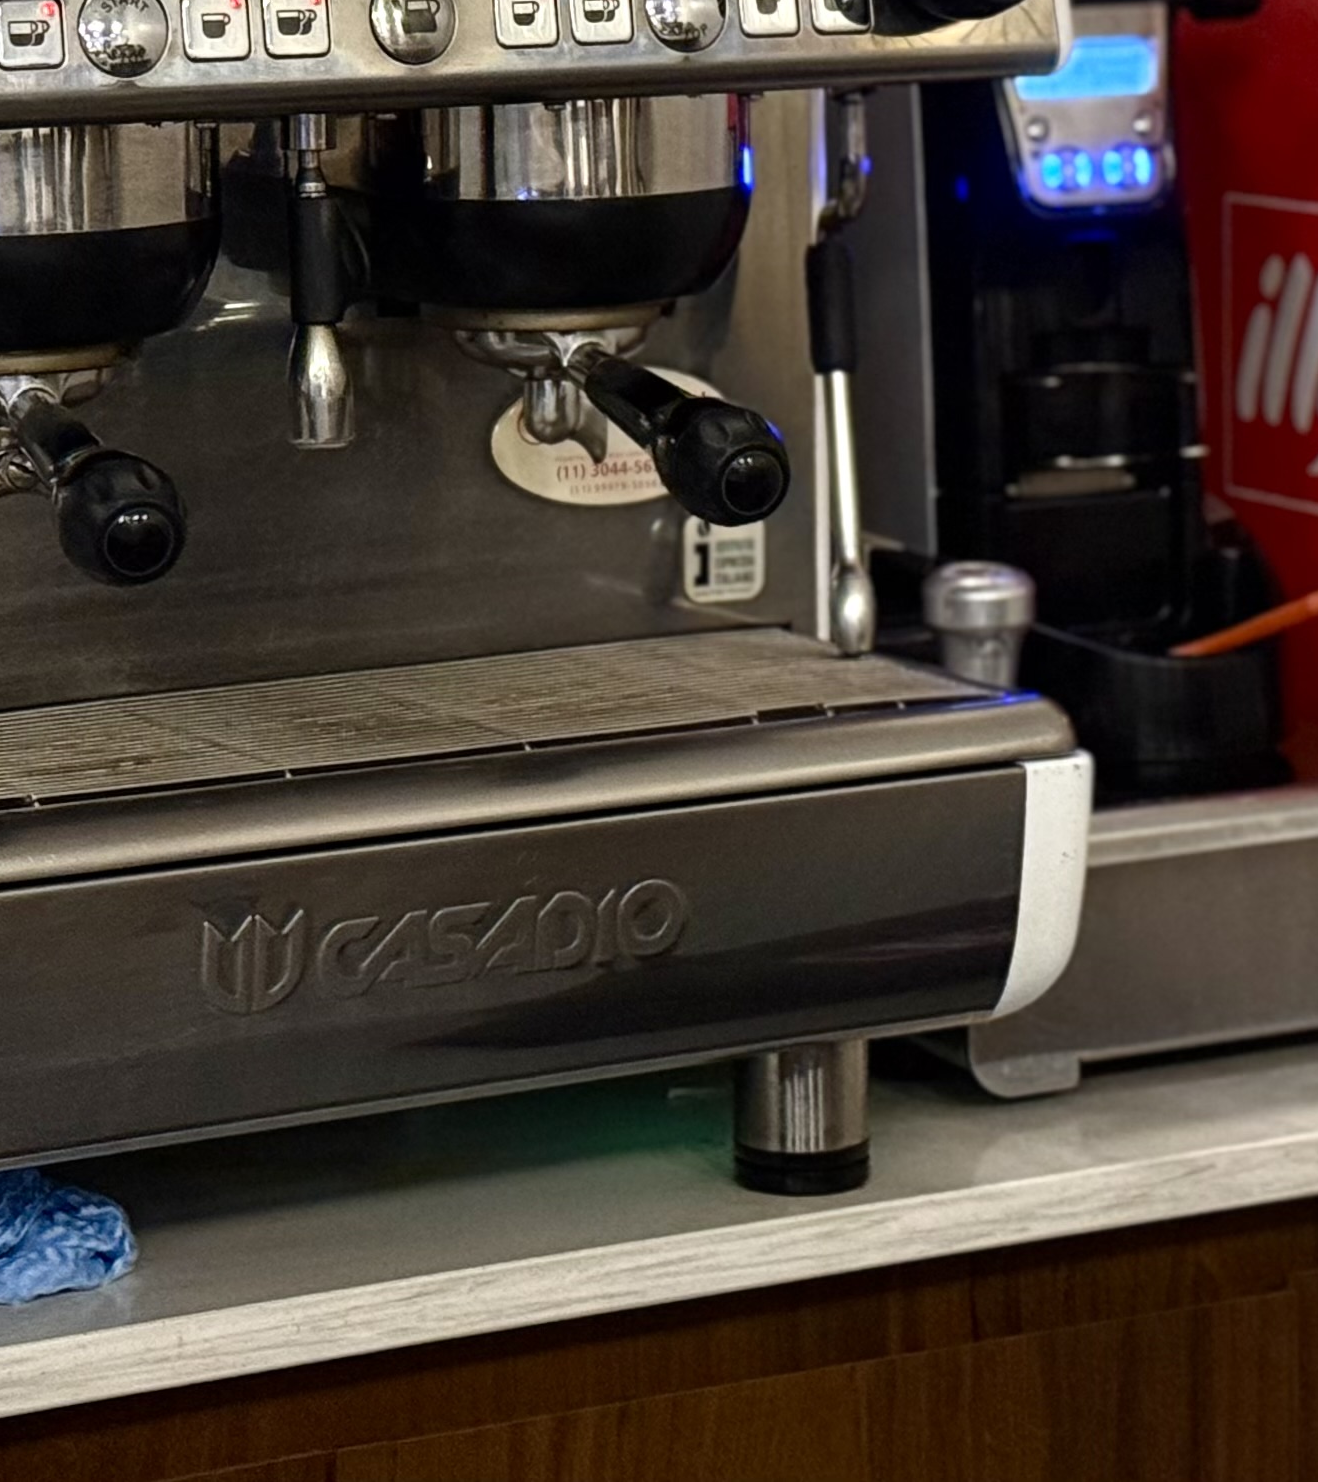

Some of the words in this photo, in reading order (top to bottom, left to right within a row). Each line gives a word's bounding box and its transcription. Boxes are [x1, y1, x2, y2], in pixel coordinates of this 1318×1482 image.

[556, 463, 586, 483] (11)
[590, 459, 657, 478] 3044-56
[317, 878, 687, 999] CASADIO
